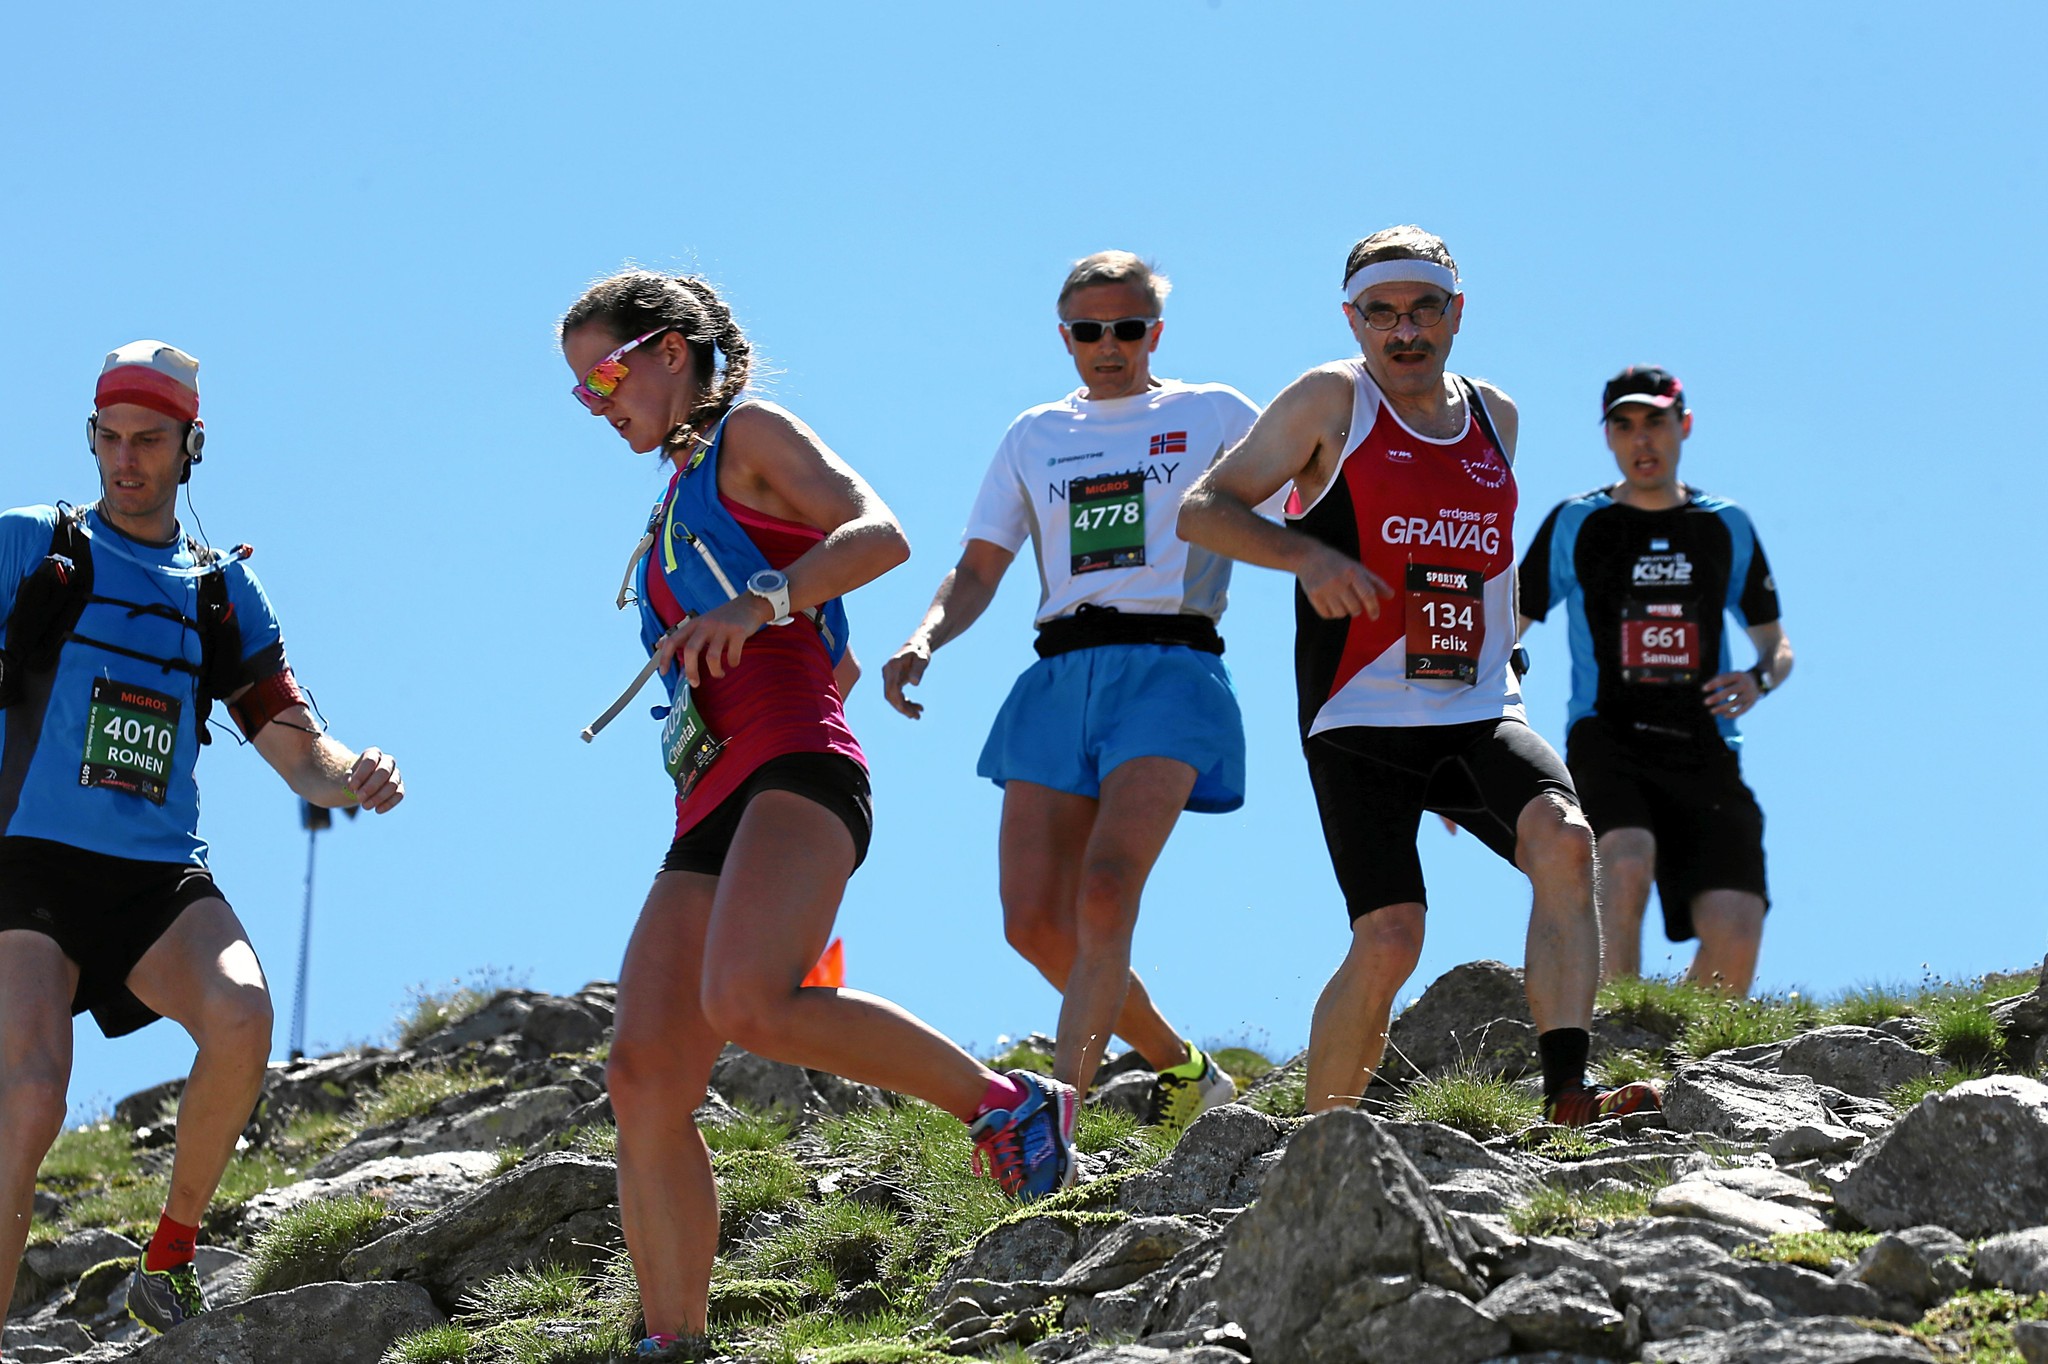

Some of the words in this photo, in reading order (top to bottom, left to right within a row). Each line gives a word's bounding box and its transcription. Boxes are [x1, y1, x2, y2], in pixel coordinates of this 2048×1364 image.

[1085, 479, 1129, 495] MIGROS
[1074, 502, 1140, 531] 4778
[1439, 508, 1481, 523] erdgas
[1381, 515, 1500, 555] GRAVAG
[1422, 602, 1474, 631] 134
[1431, 634, 1468, 652] Felix
[1641, 626, 1686, 649] 661
[1641, 651, 1690, 665] Samuel
[121, 691, 168, 712] MIGROS
[103, 716, 172, 755] 4010
[668, 716, 697, 765] Chantal
[108, 746, 164, 775] RONEN
[80, 764, 91, 785] 4010
